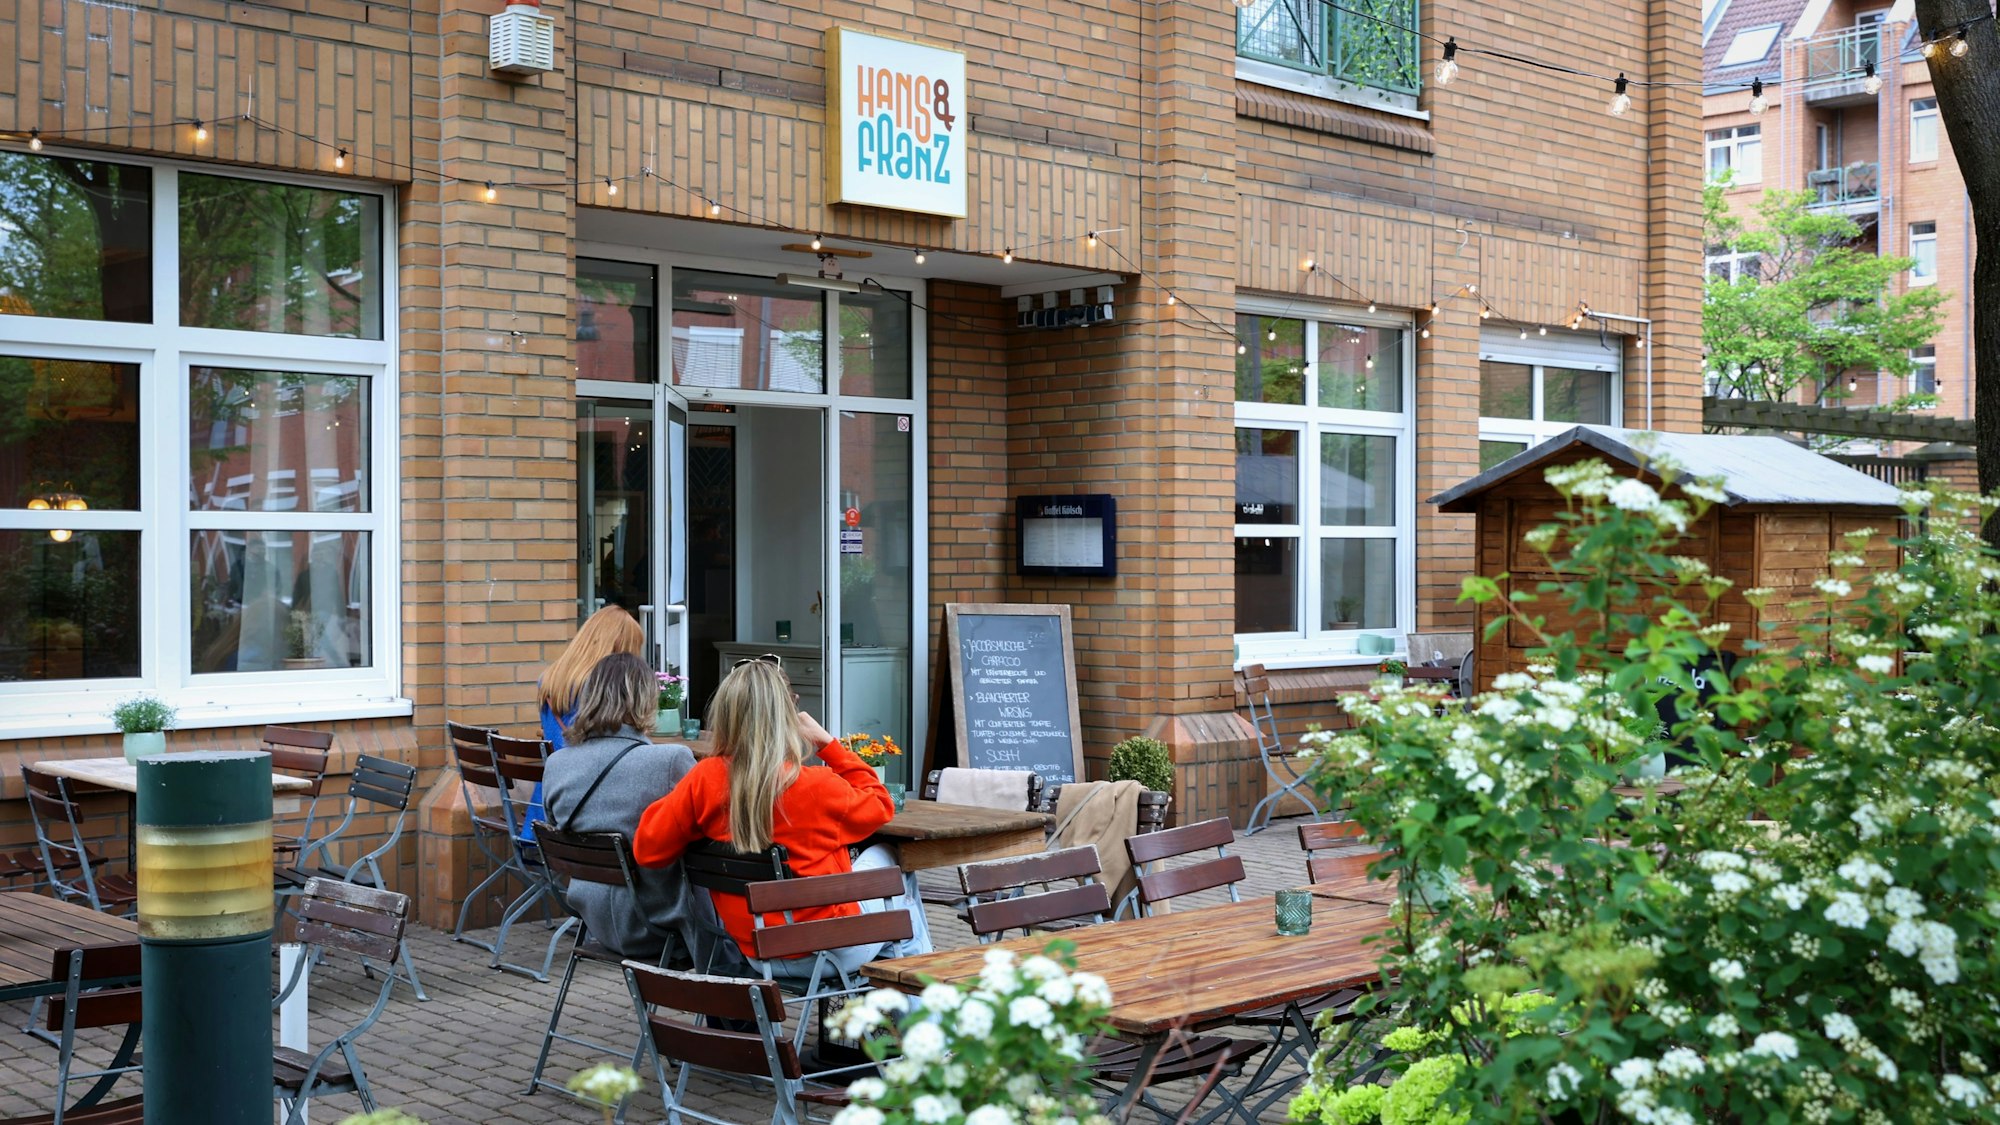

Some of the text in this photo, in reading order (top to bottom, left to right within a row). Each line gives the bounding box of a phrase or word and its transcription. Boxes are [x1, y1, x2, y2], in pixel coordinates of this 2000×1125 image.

[975, 691, 1030, 704] BLANCHIERTER
[998, 704, 1032, 719] WIRSING
[974, 719, 987, 728] MIT
[985, 747, 1021, 762] SUSHI
